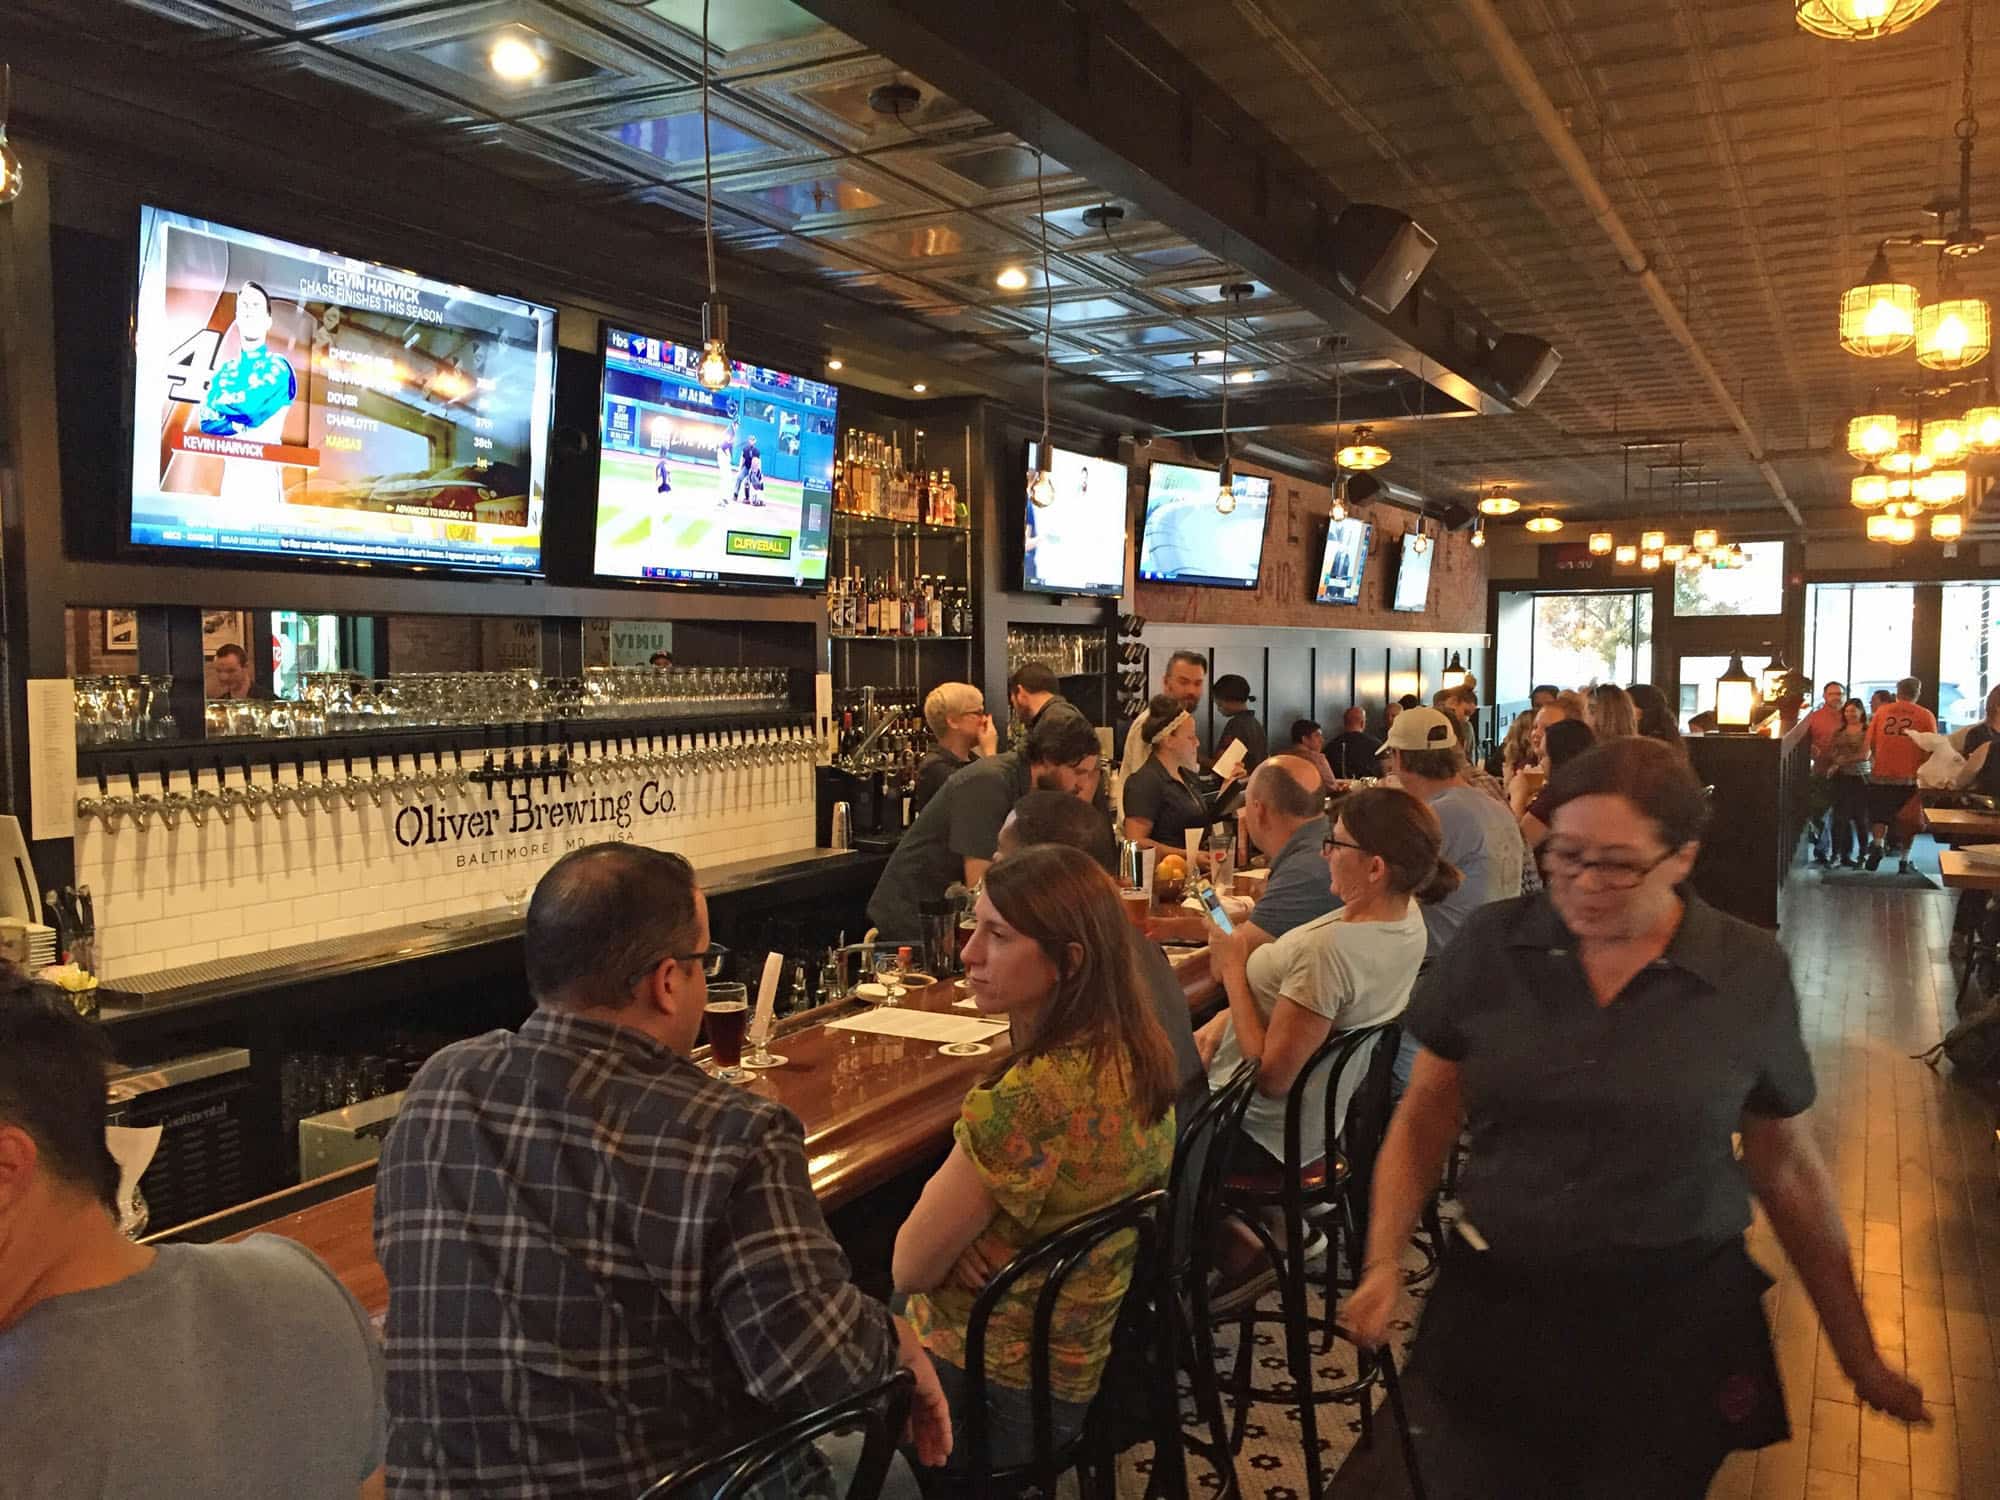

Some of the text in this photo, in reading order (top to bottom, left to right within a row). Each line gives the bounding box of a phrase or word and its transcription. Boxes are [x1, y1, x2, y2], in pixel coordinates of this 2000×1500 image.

[327, 267, 420, 305] KEVIN HARVICK
[300, 279, 444, 324] CHASE FINISHES THIS SEASON
[612, 333, 629, 349] tbs
[327, 391, 359, 408] DOVER
[326, 414, 379, 432] CHARLOTTE
[183, 435, 264, 458] KEVIN HARVICK
[734, 537, 784, 553] CURVEBALL
[1884, 716, 1913, 737] 22
[395, 781, 677, 847] Oliver Brewing Co.
[456, 843, 549, 868] BALTIMORE
[566, 838, 586, 851] MD
